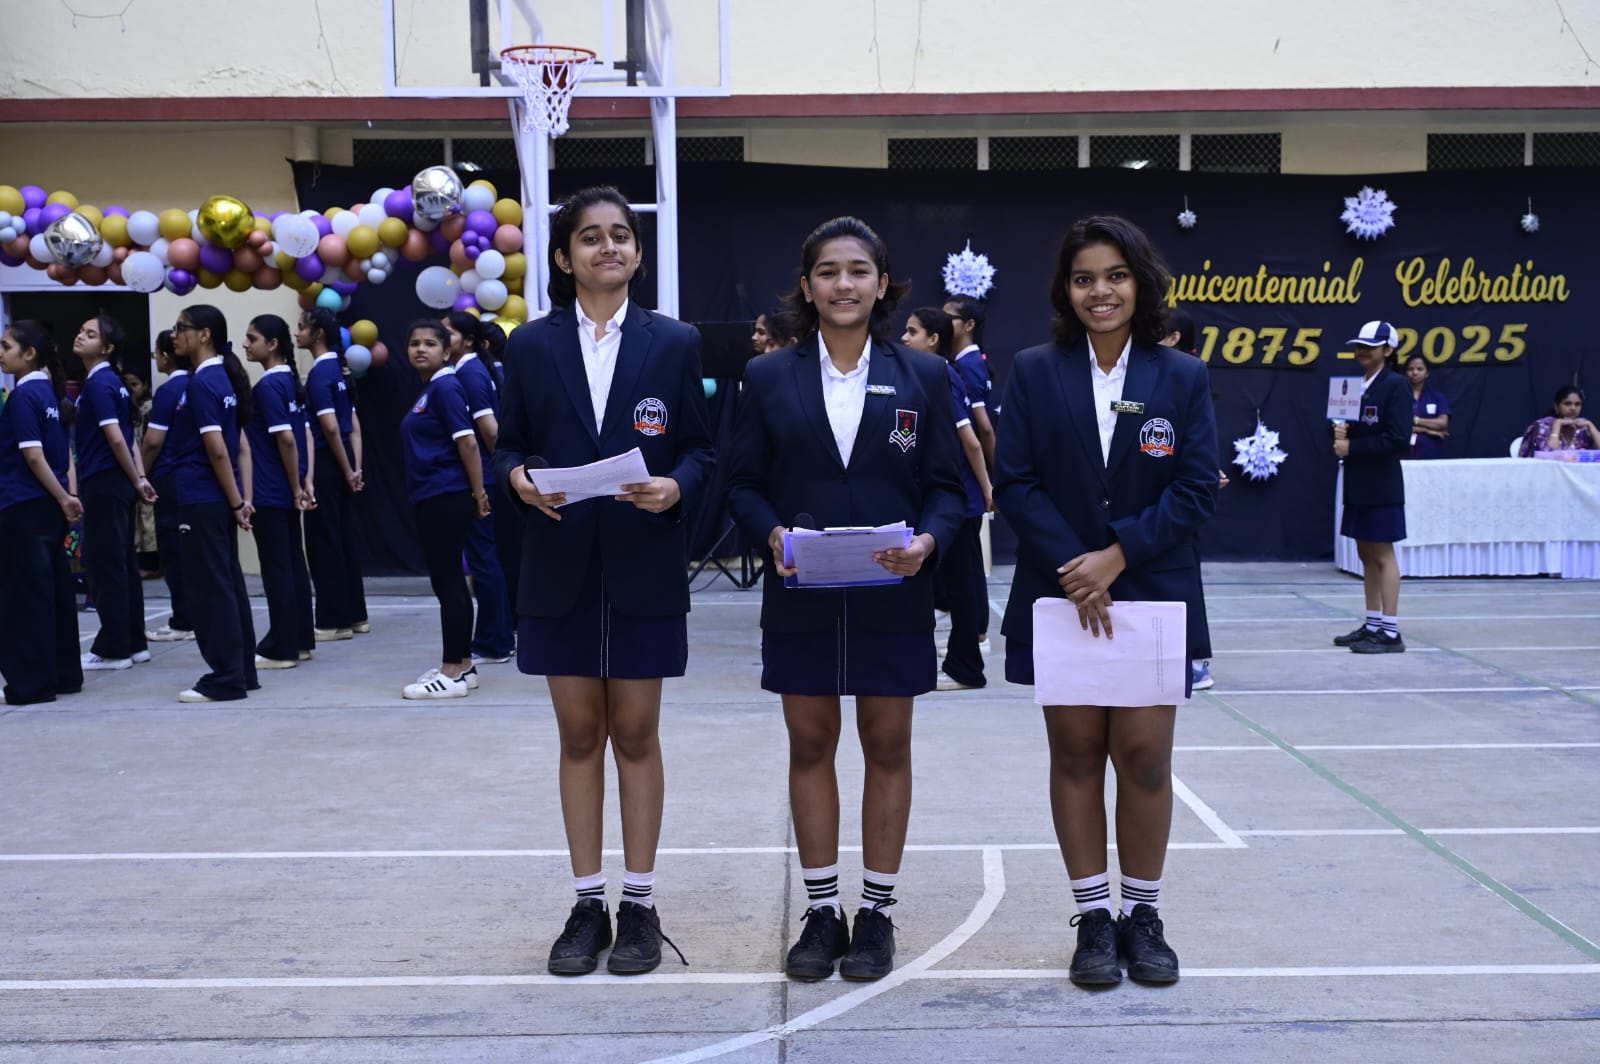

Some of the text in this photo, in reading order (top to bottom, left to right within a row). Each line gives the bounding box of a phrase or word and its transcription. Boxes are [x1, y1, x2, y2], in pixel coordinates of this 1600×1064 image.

[1395, 256, 1570, 308] Celebration
[1201, 326, 1323, 366] 1875
[1396, 324, 1529, 366] 2025
